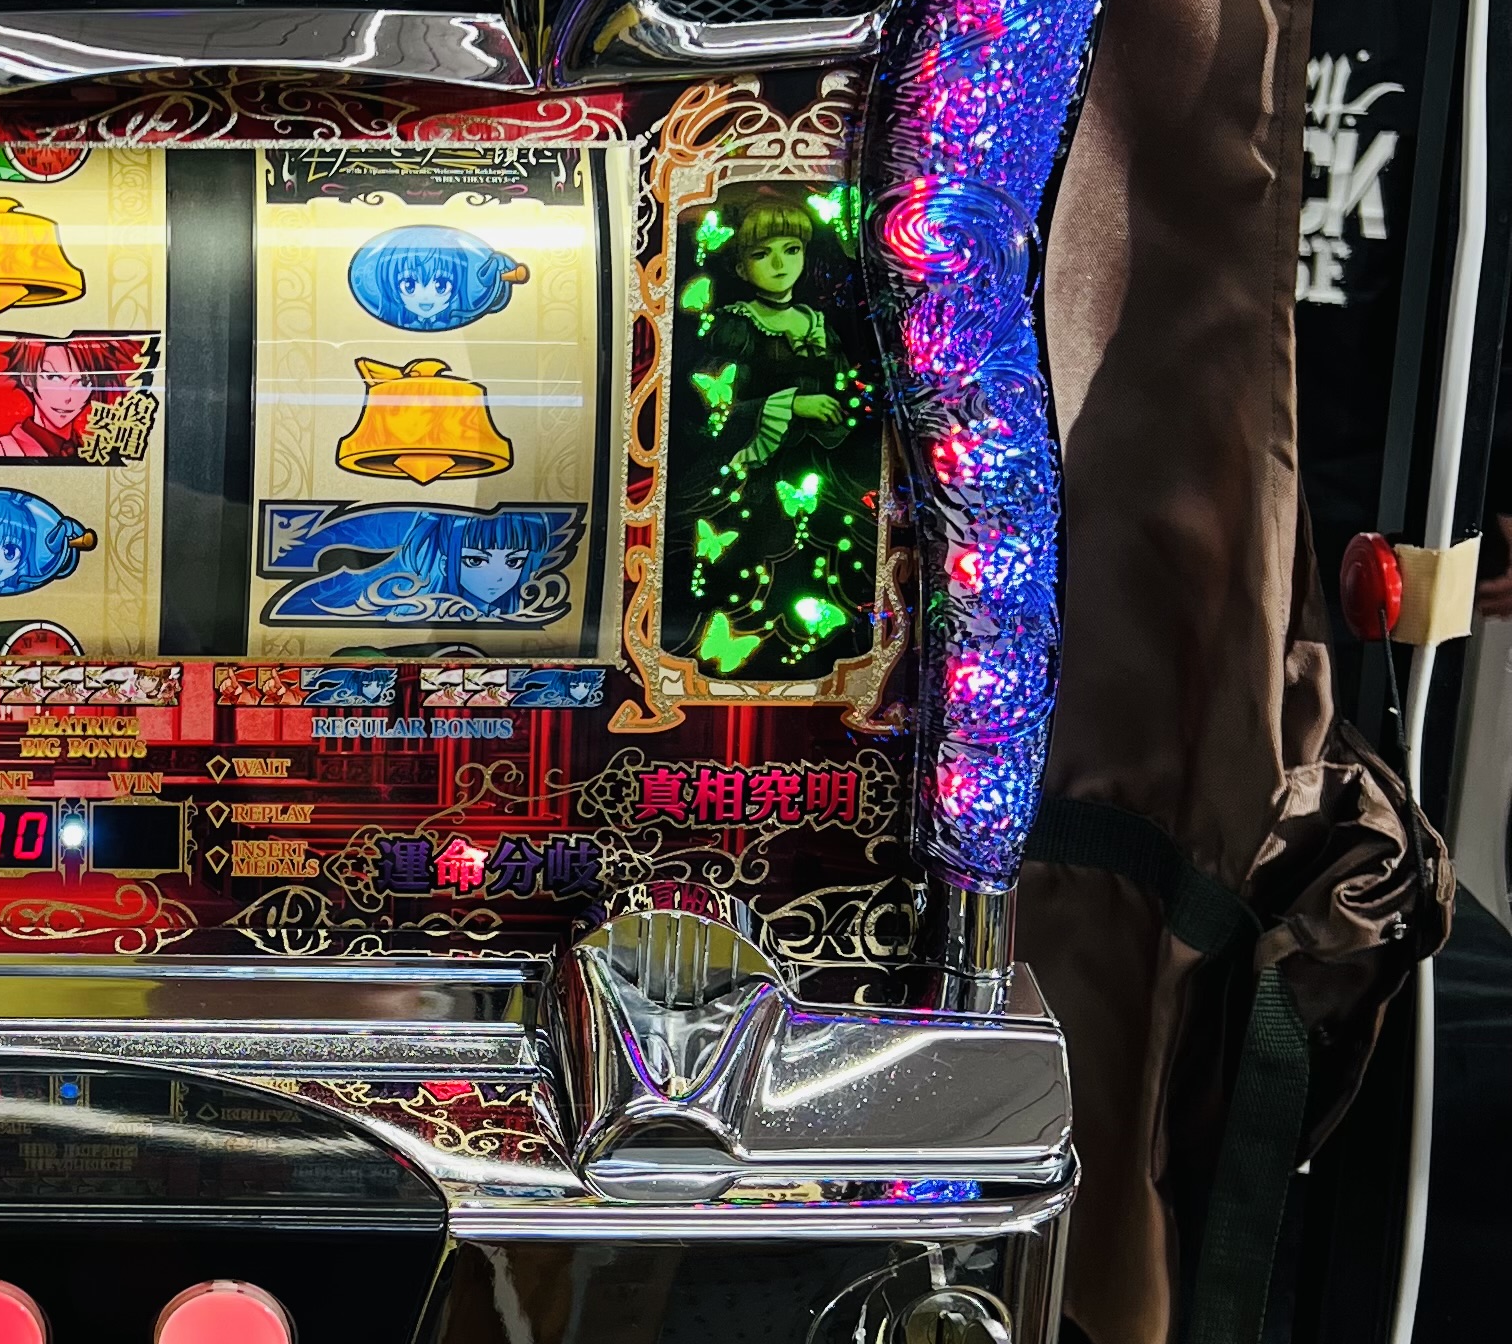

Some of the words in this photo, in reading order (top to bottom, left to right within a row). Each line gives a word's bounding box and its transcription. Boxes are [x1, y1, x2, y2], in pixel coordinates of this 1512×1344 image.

[26, 716, 140, 737] BEATRICE
[310, 716, 427, 739] REGULAR
[431, 717, 513, 740] BONUS
[19, 738, 62, 759] BIG
[66, 738, 148, 759] BONUS
[232, 758, 291, 777] WAIT
[108, 772, 163, 793] WIN
[633, 766, 859, 825] 真相究明
[231, 805, 315, 823] REPLAY
[232, 840, 309, 859] INSERT
[231, 858, 320, 878] MEDALS
[377, 837, 601, 897] 運命分岐
